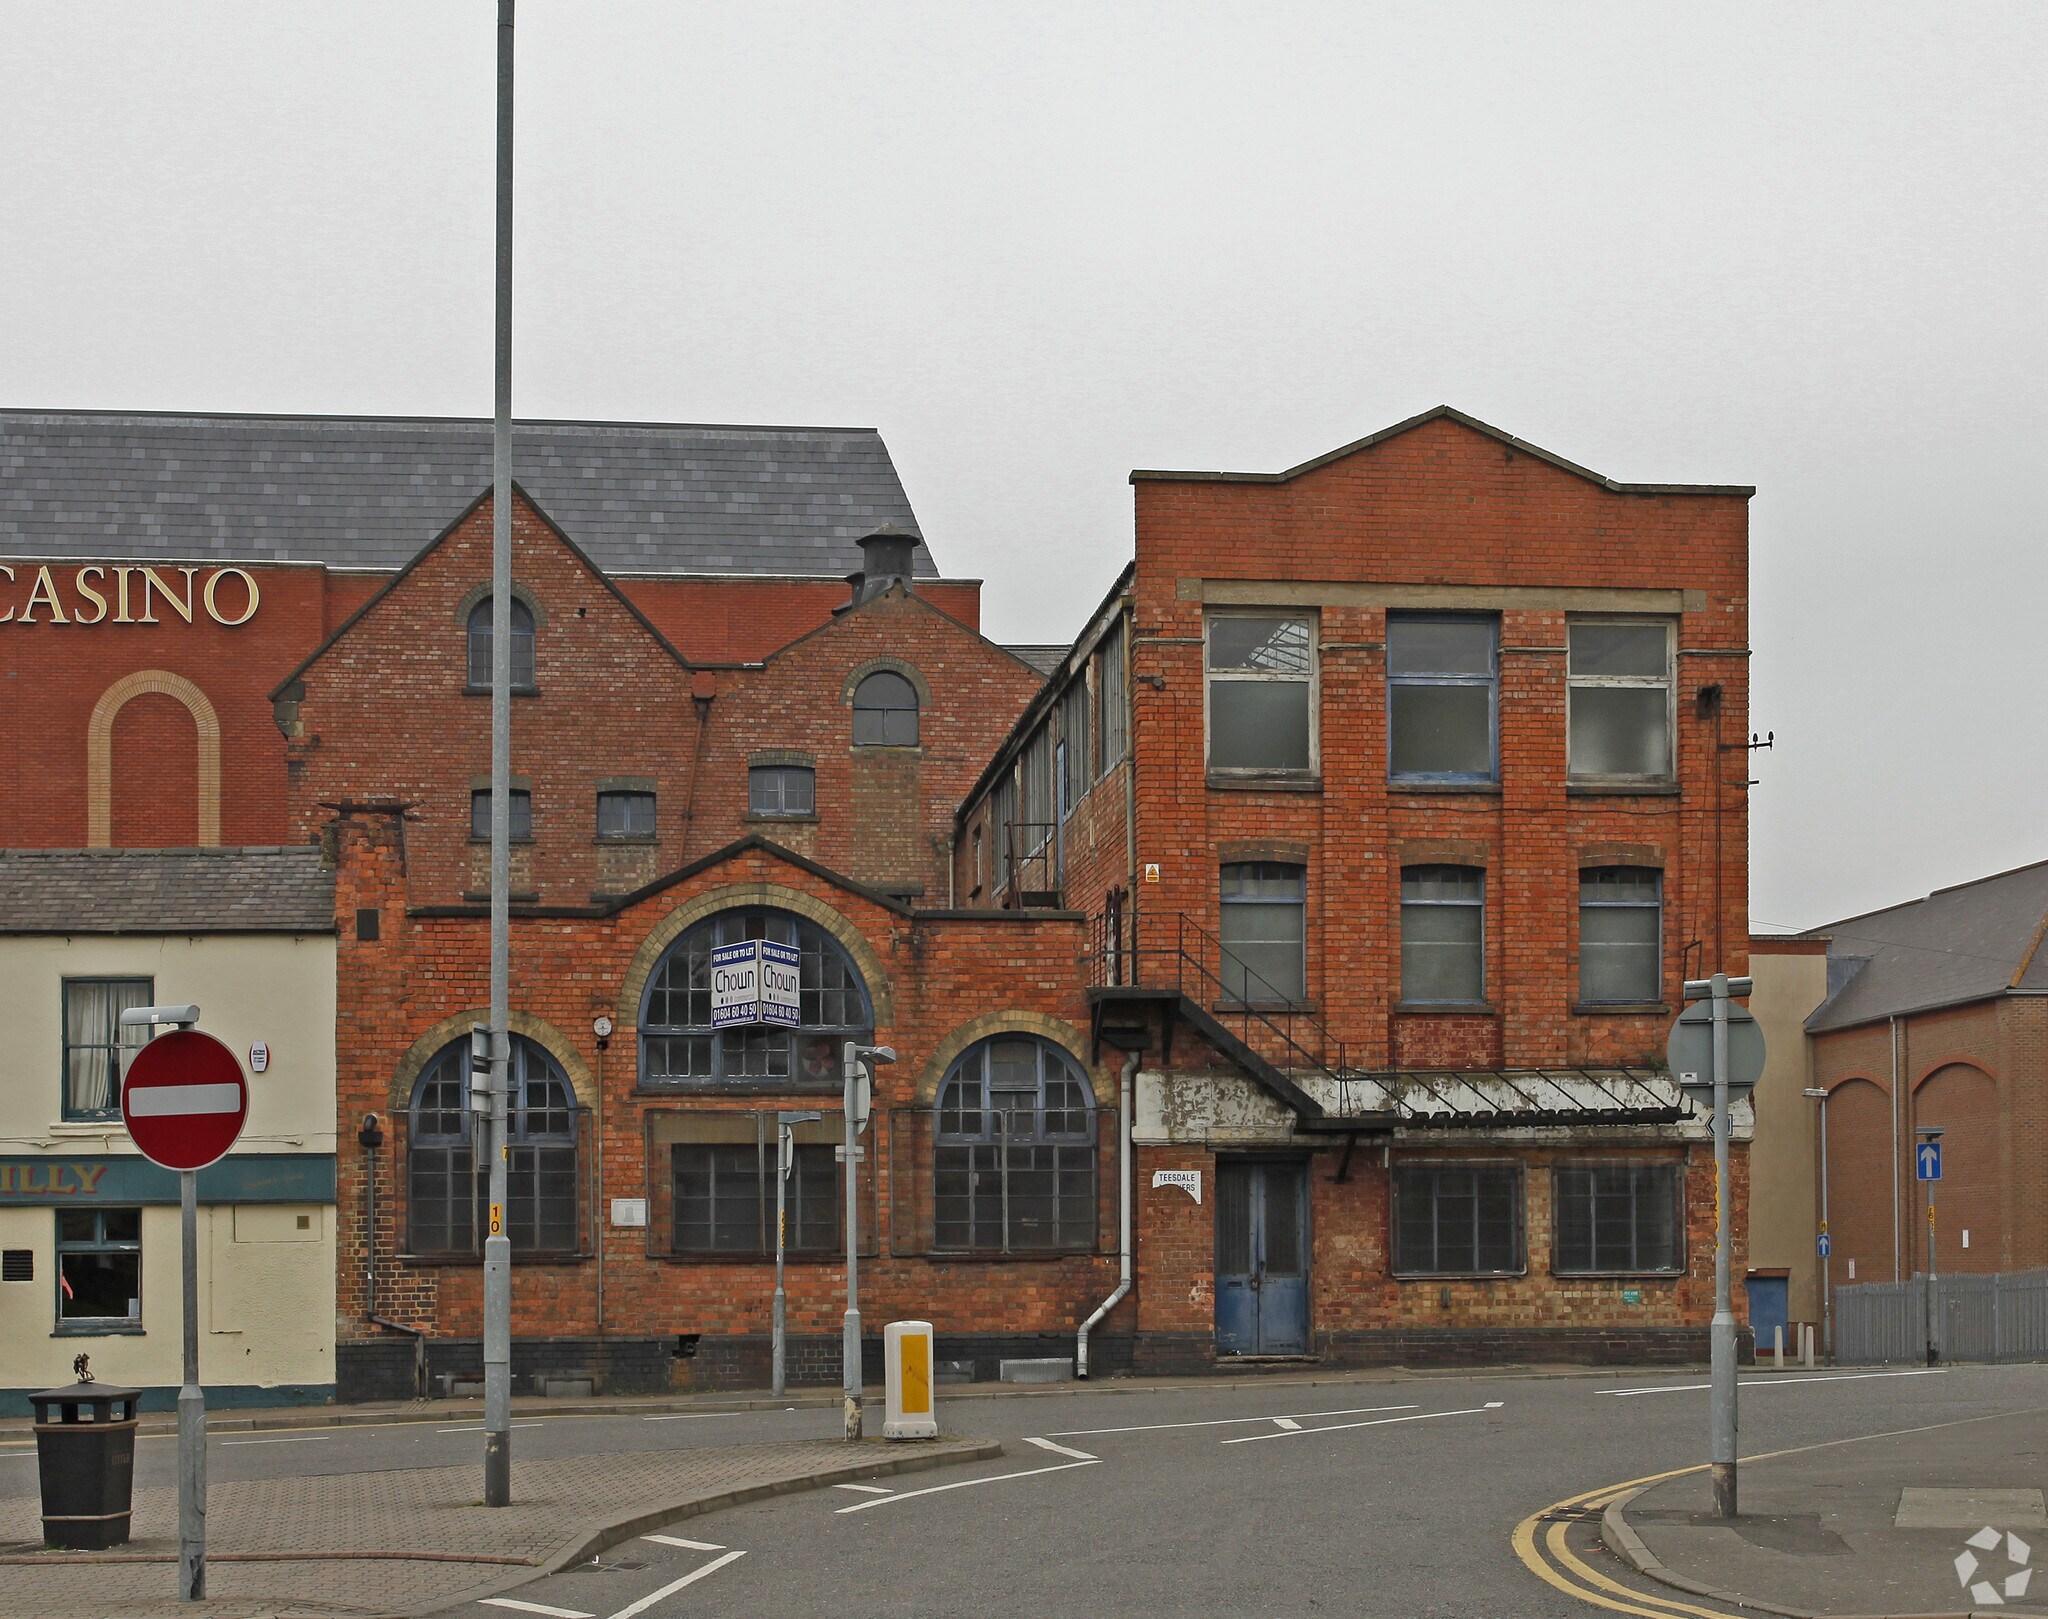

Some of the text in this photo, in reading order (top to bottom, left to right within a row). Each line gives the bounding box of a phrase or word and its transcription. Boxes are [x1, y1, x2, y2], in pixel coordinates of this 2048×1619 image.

[713, 946, 754, 963] FOR SALE OR TO LET
[763, 946, 771, 956] FOR
[771, 948, 780, 958] SALE
[780, 950, 786, 959] OR
[786, 951, 791, 960] TO
[715, 969, 755, 993] Chown
[764, 964, 797, 994] Chown
[713, 1002, 757, 1020] 01604 60 40 50
[763, 1003, 798, 1020] 01604 60 40 50
